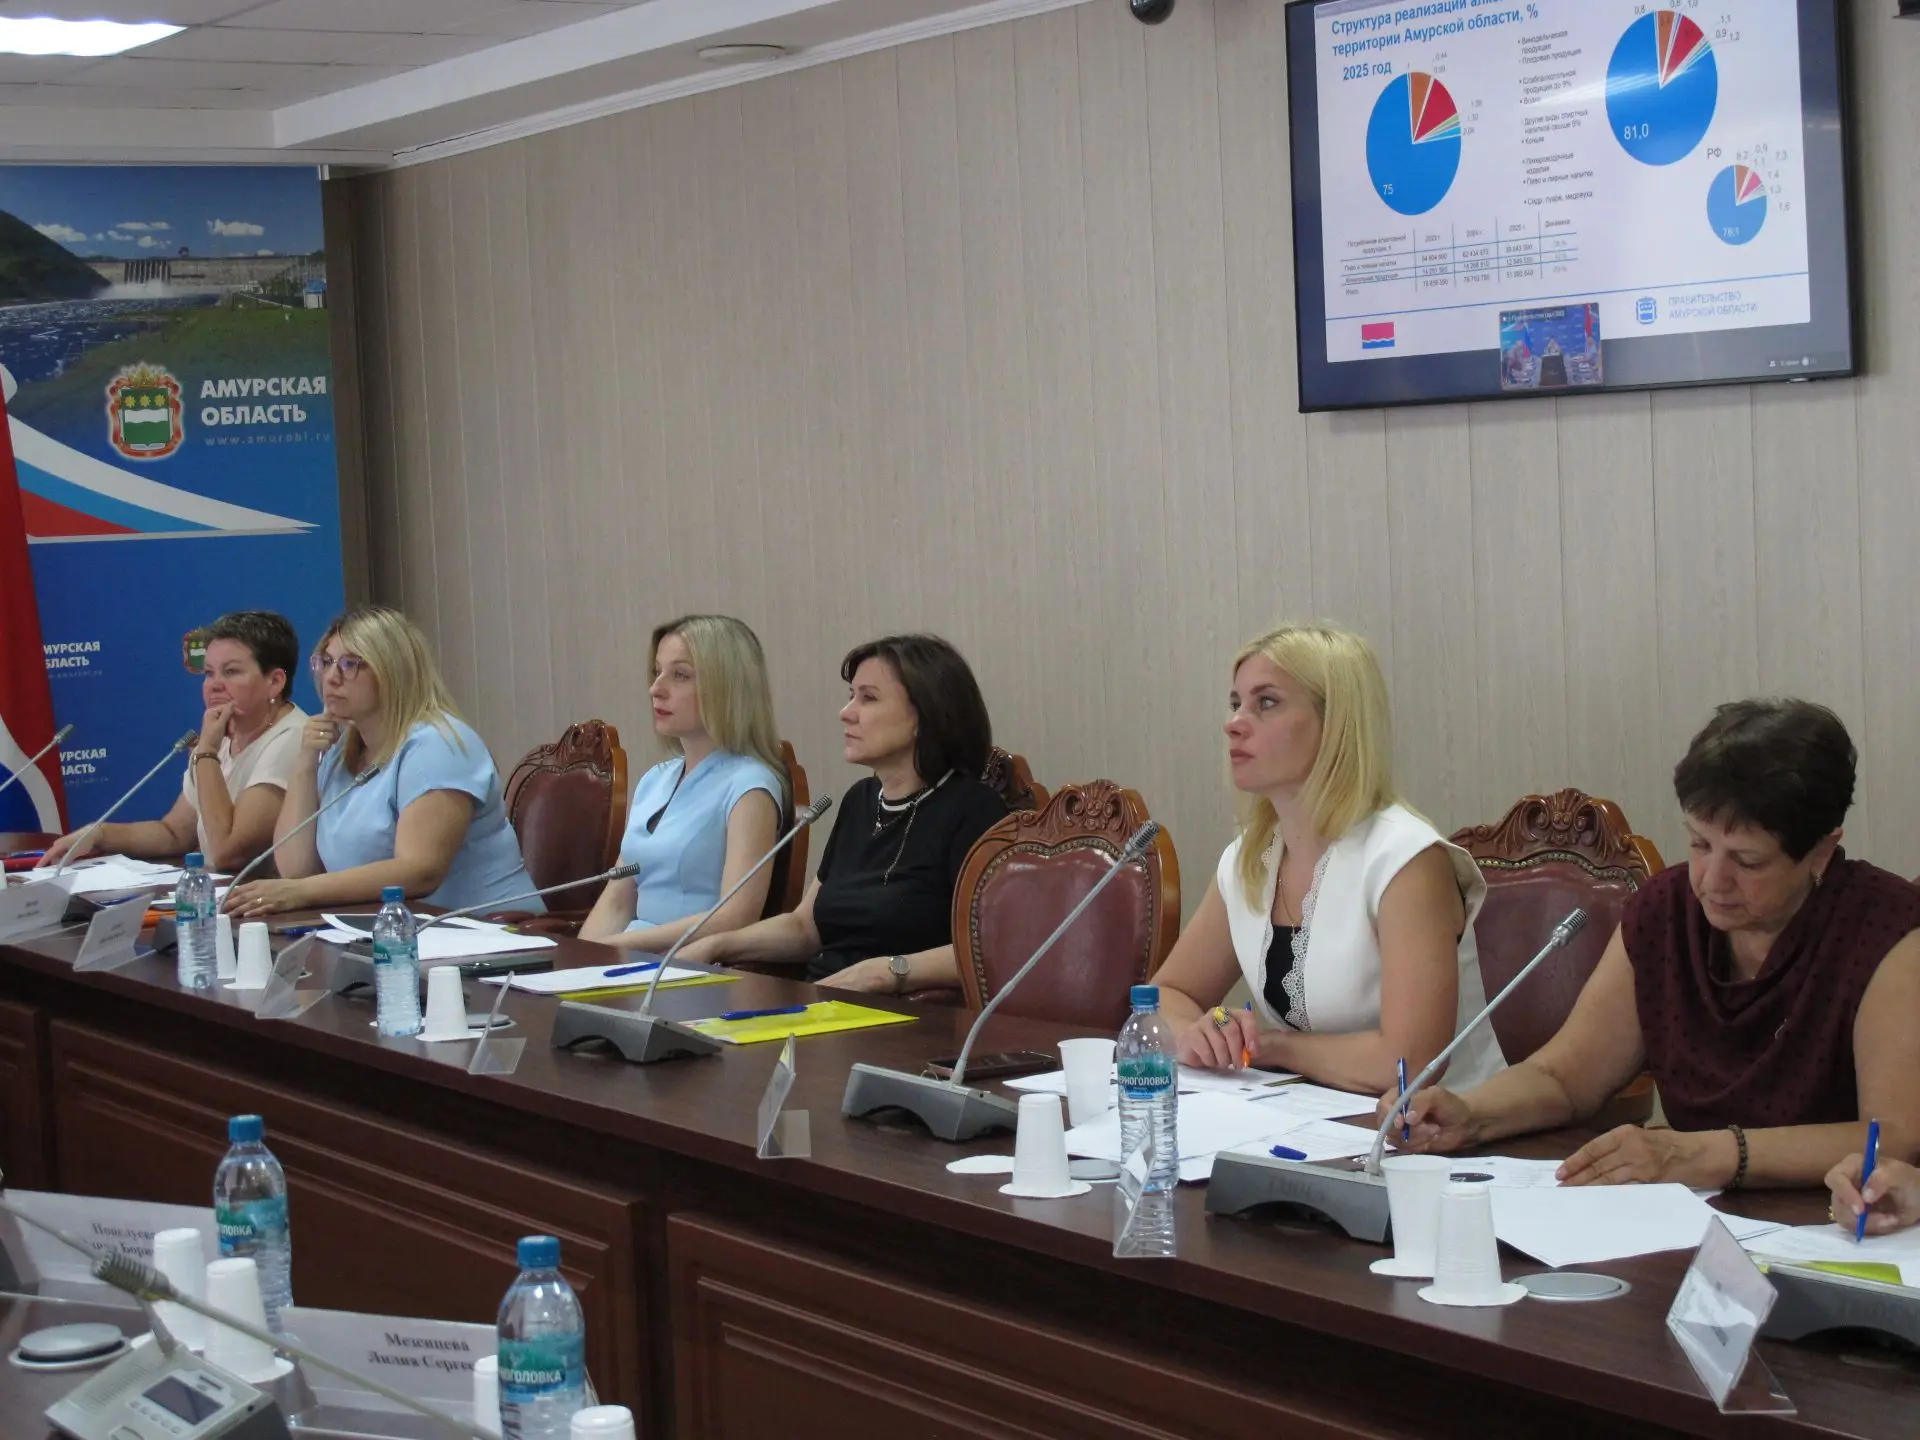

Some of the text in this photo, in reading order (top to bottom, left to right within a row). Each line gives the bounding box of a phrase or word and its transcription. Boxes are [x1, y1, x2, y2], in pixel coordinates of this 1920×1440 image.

[1332, 13, 1391, 36] Структура
[1395, 0, 1467, 26] реализации
[1332, 3, 1538, 57] территории Амурской области, %
[1343, 63, 1369, 81] 2025
[1372, 61, 1392, 77] год
[1623, 123, 1649, 140] 81,0
[1707, 147, 1721, 159] РФ
[1382, 183, 1394, 196] 75
[201, 376, 327, 399] АМУРСКАЯ
[201, 404, 307, 426] ОБЛАСТЬ
[205, 431, 330, 446] www.amurobl.ru
[44, 641, 101, 655] МУРСКАЯ
[46, 656, 90, 669] БЛАСТЬ
[60, 748, 107, 762] УРСКАЯ
[62, 764, 96, 776] АСТЬ
[1119, 1076, 1170, 1086] ЕРНОГОЛОВКА
[384, 1332, 470, 1351] Мезенцева
[368, 1352, 475, 1373] Лилия Сергее
